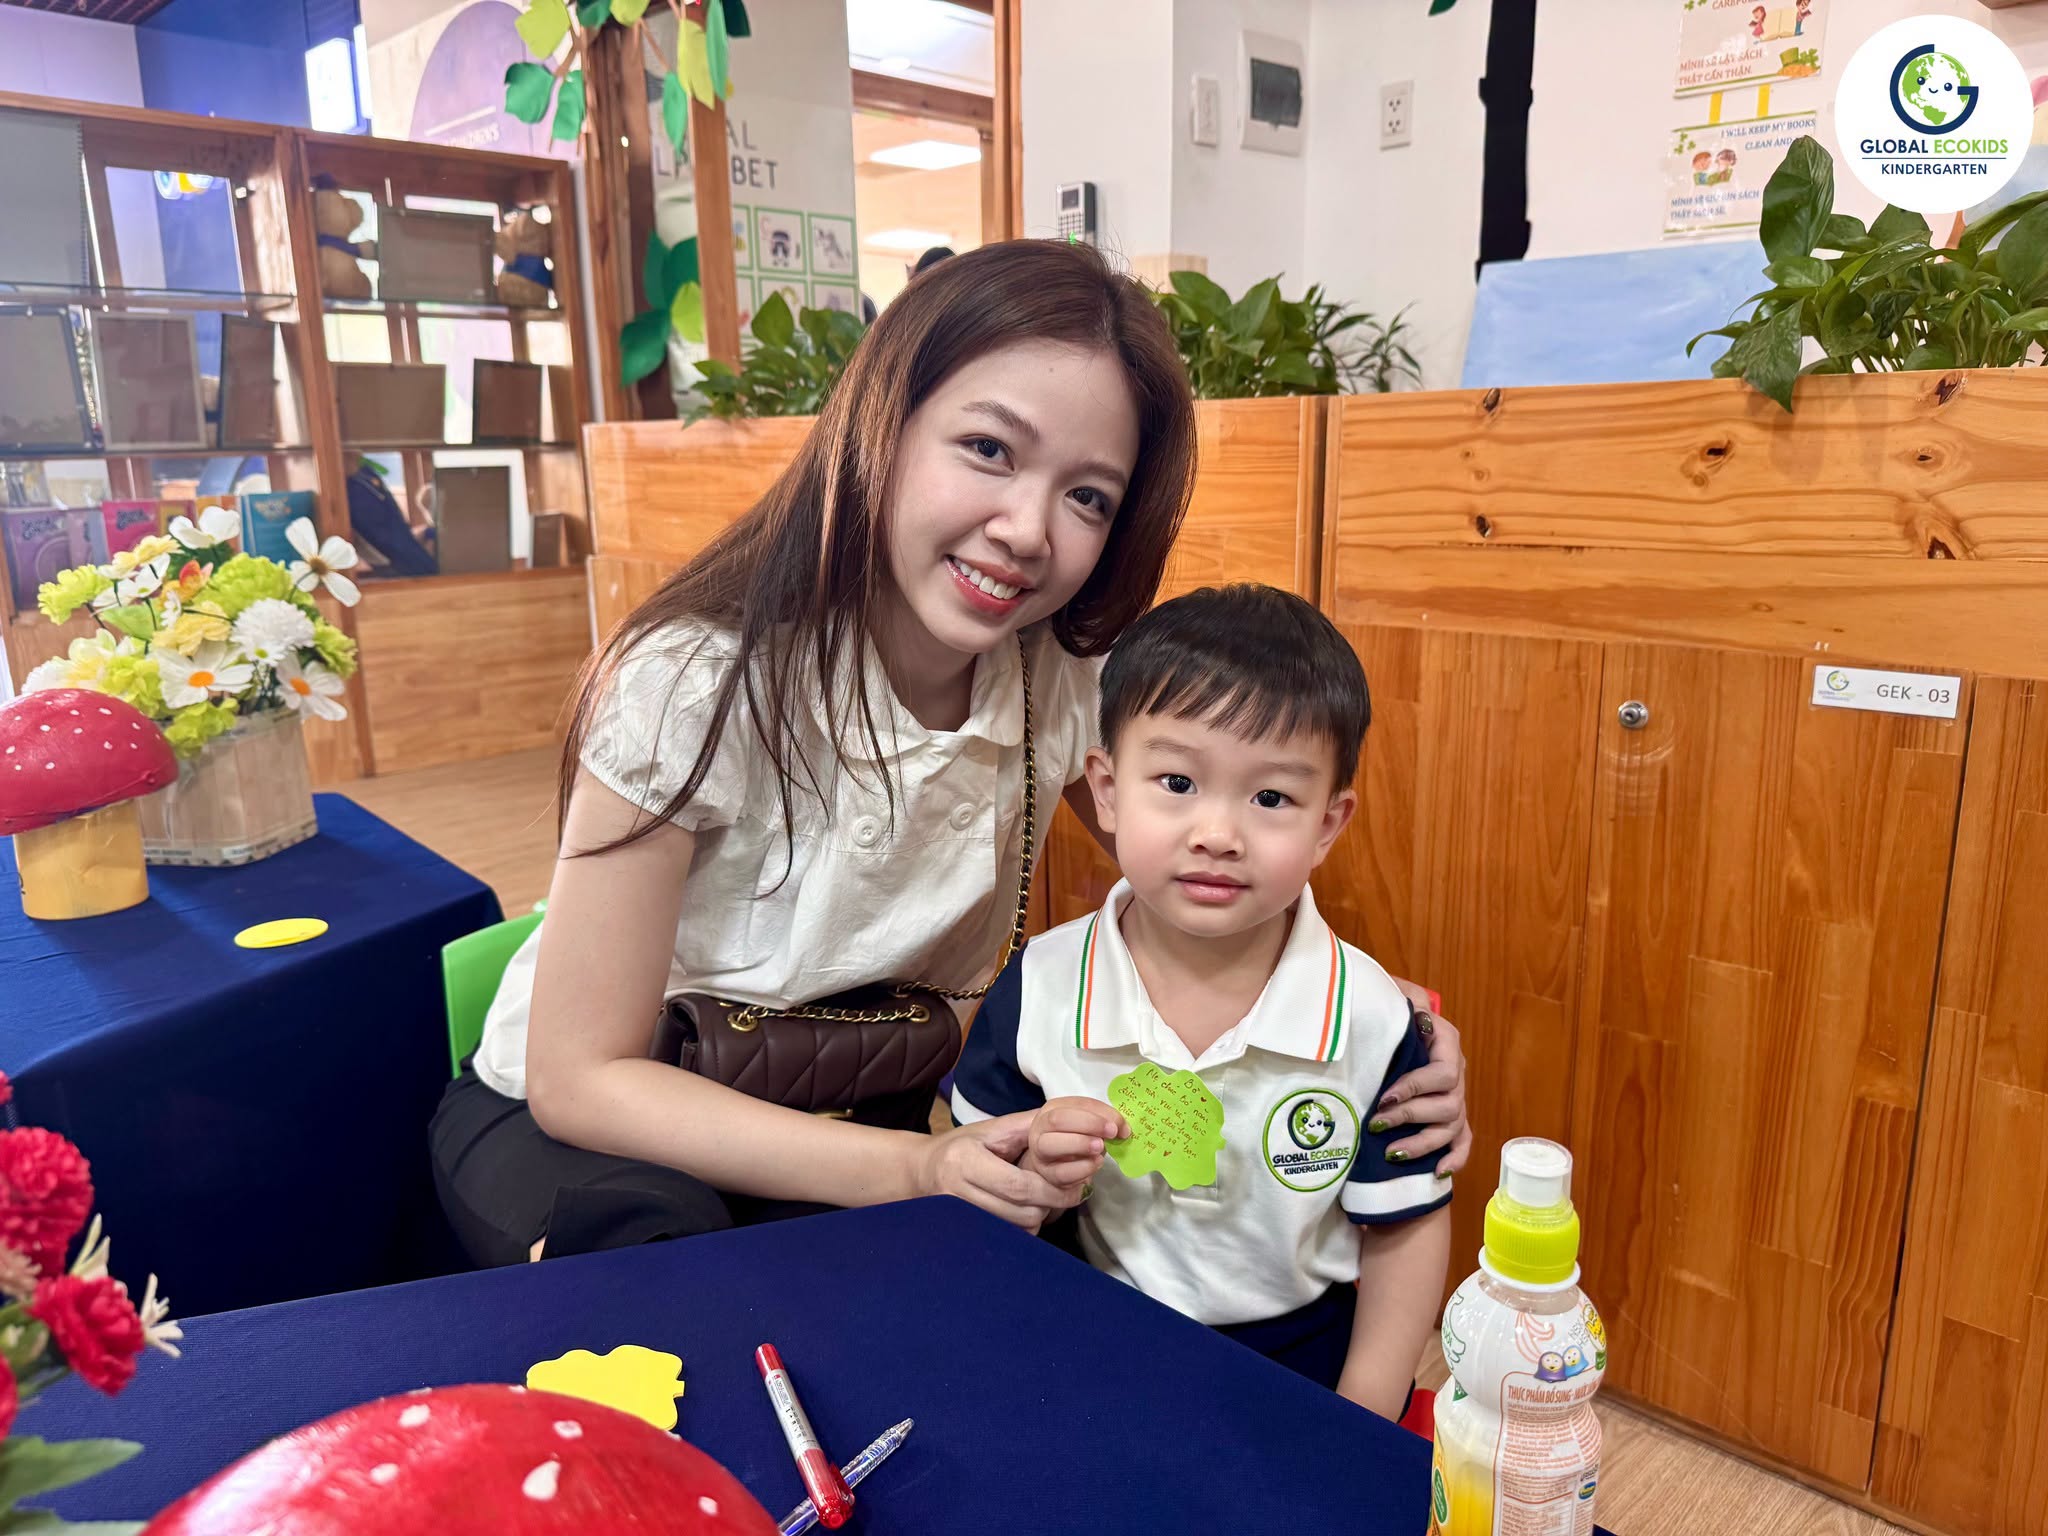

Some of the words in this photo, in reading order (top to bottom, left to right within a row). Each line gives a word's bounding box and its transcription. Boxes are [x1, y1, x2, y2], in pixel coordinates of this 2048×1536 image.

[1748, 124, 1771, 137] KEEP
[1772, 121, 1787, 135] MY
[1787, 117, 1817, 131] BOOKS
[1744, 138, 1773, 151] CLEAN
[1876, 683, 1912, 700] GEK
[1928, 688, 1950, 703] 03
[1272, 1152, 1310, 1165] GLOBAL
[1310, 1147, 1350, 1161] ECOKIDS
[1284, 1161, 1339, 1176] KINDERGARTEN
